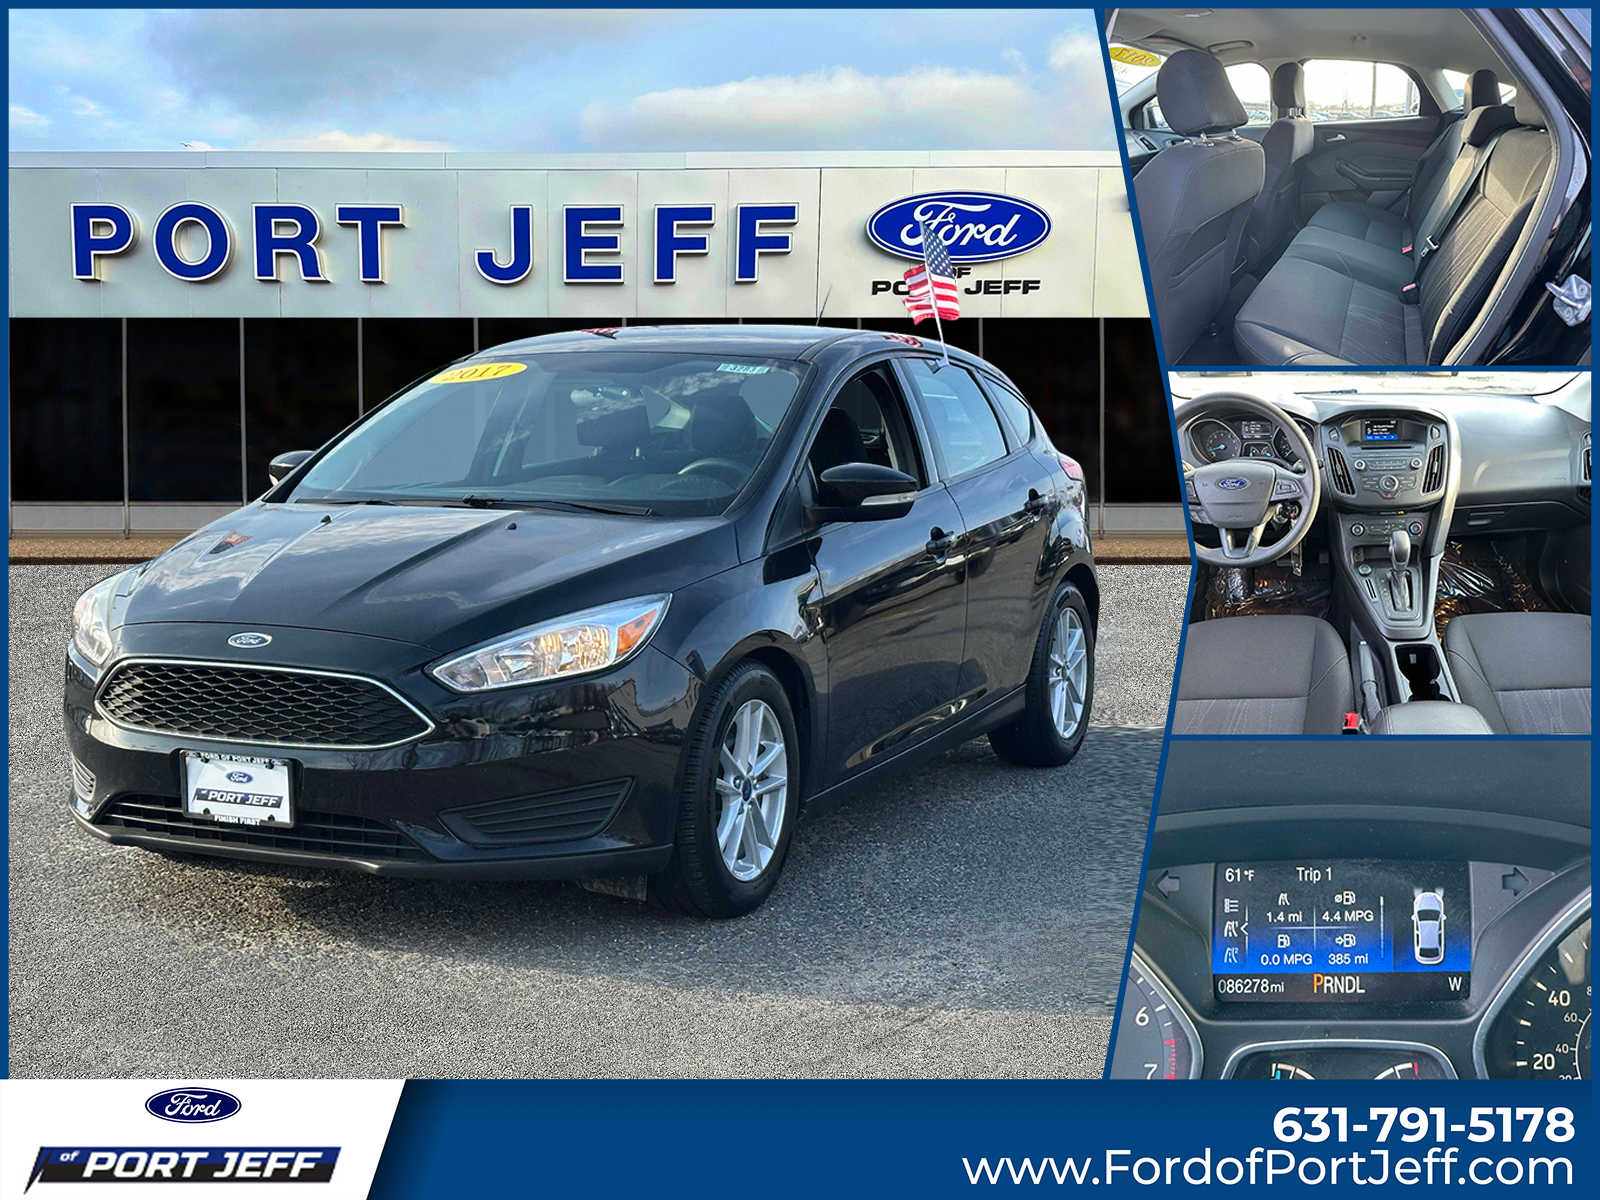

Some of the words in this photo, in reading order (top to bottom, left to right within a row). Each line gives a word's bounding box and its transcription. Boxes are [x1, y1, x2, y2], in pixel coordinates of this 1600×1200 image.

[900, 200, 1022, 247] Ford
[70, 201, 405, 283] PORT
[474, 202, 798, 285] JEFF
[964, 280, 1041, 295] JEFF
[440, 364, 513, 381] 2017
[207, 790, 246, 804] PORT
[245, 794, 279, 807] JEFF
[1296, 866, 1322, 883] Trip
[1325, 867, 1332, 881] 1
[1266, 912, 1285, 923] 1.4
[1288, 911, 1303, 923] mi
[1322, 911, 1342, 922] 4.4
[1344, 910, 1375, 923] MPG
[1260, 953, 1281, 966] 0.0
[1283, 953, 1313, 966] MPG
[1328, 953, 1351, 965] 385
[1354, 953, 1369, 965] mi
[1313, 973, 1366, 994] PRNDL
[1448, 976, 1462, 992] W
[1548, 990, 1571, 1007] 40
[1135, 1006, 1150, 1026] 6
[1563, 1012, 1578, 1023] 60
[1555, 1043, 1569, 1054] 40
[1533, 1053, 1556, 1070] 20
[1144, 1063, 1158, 1080] 7
